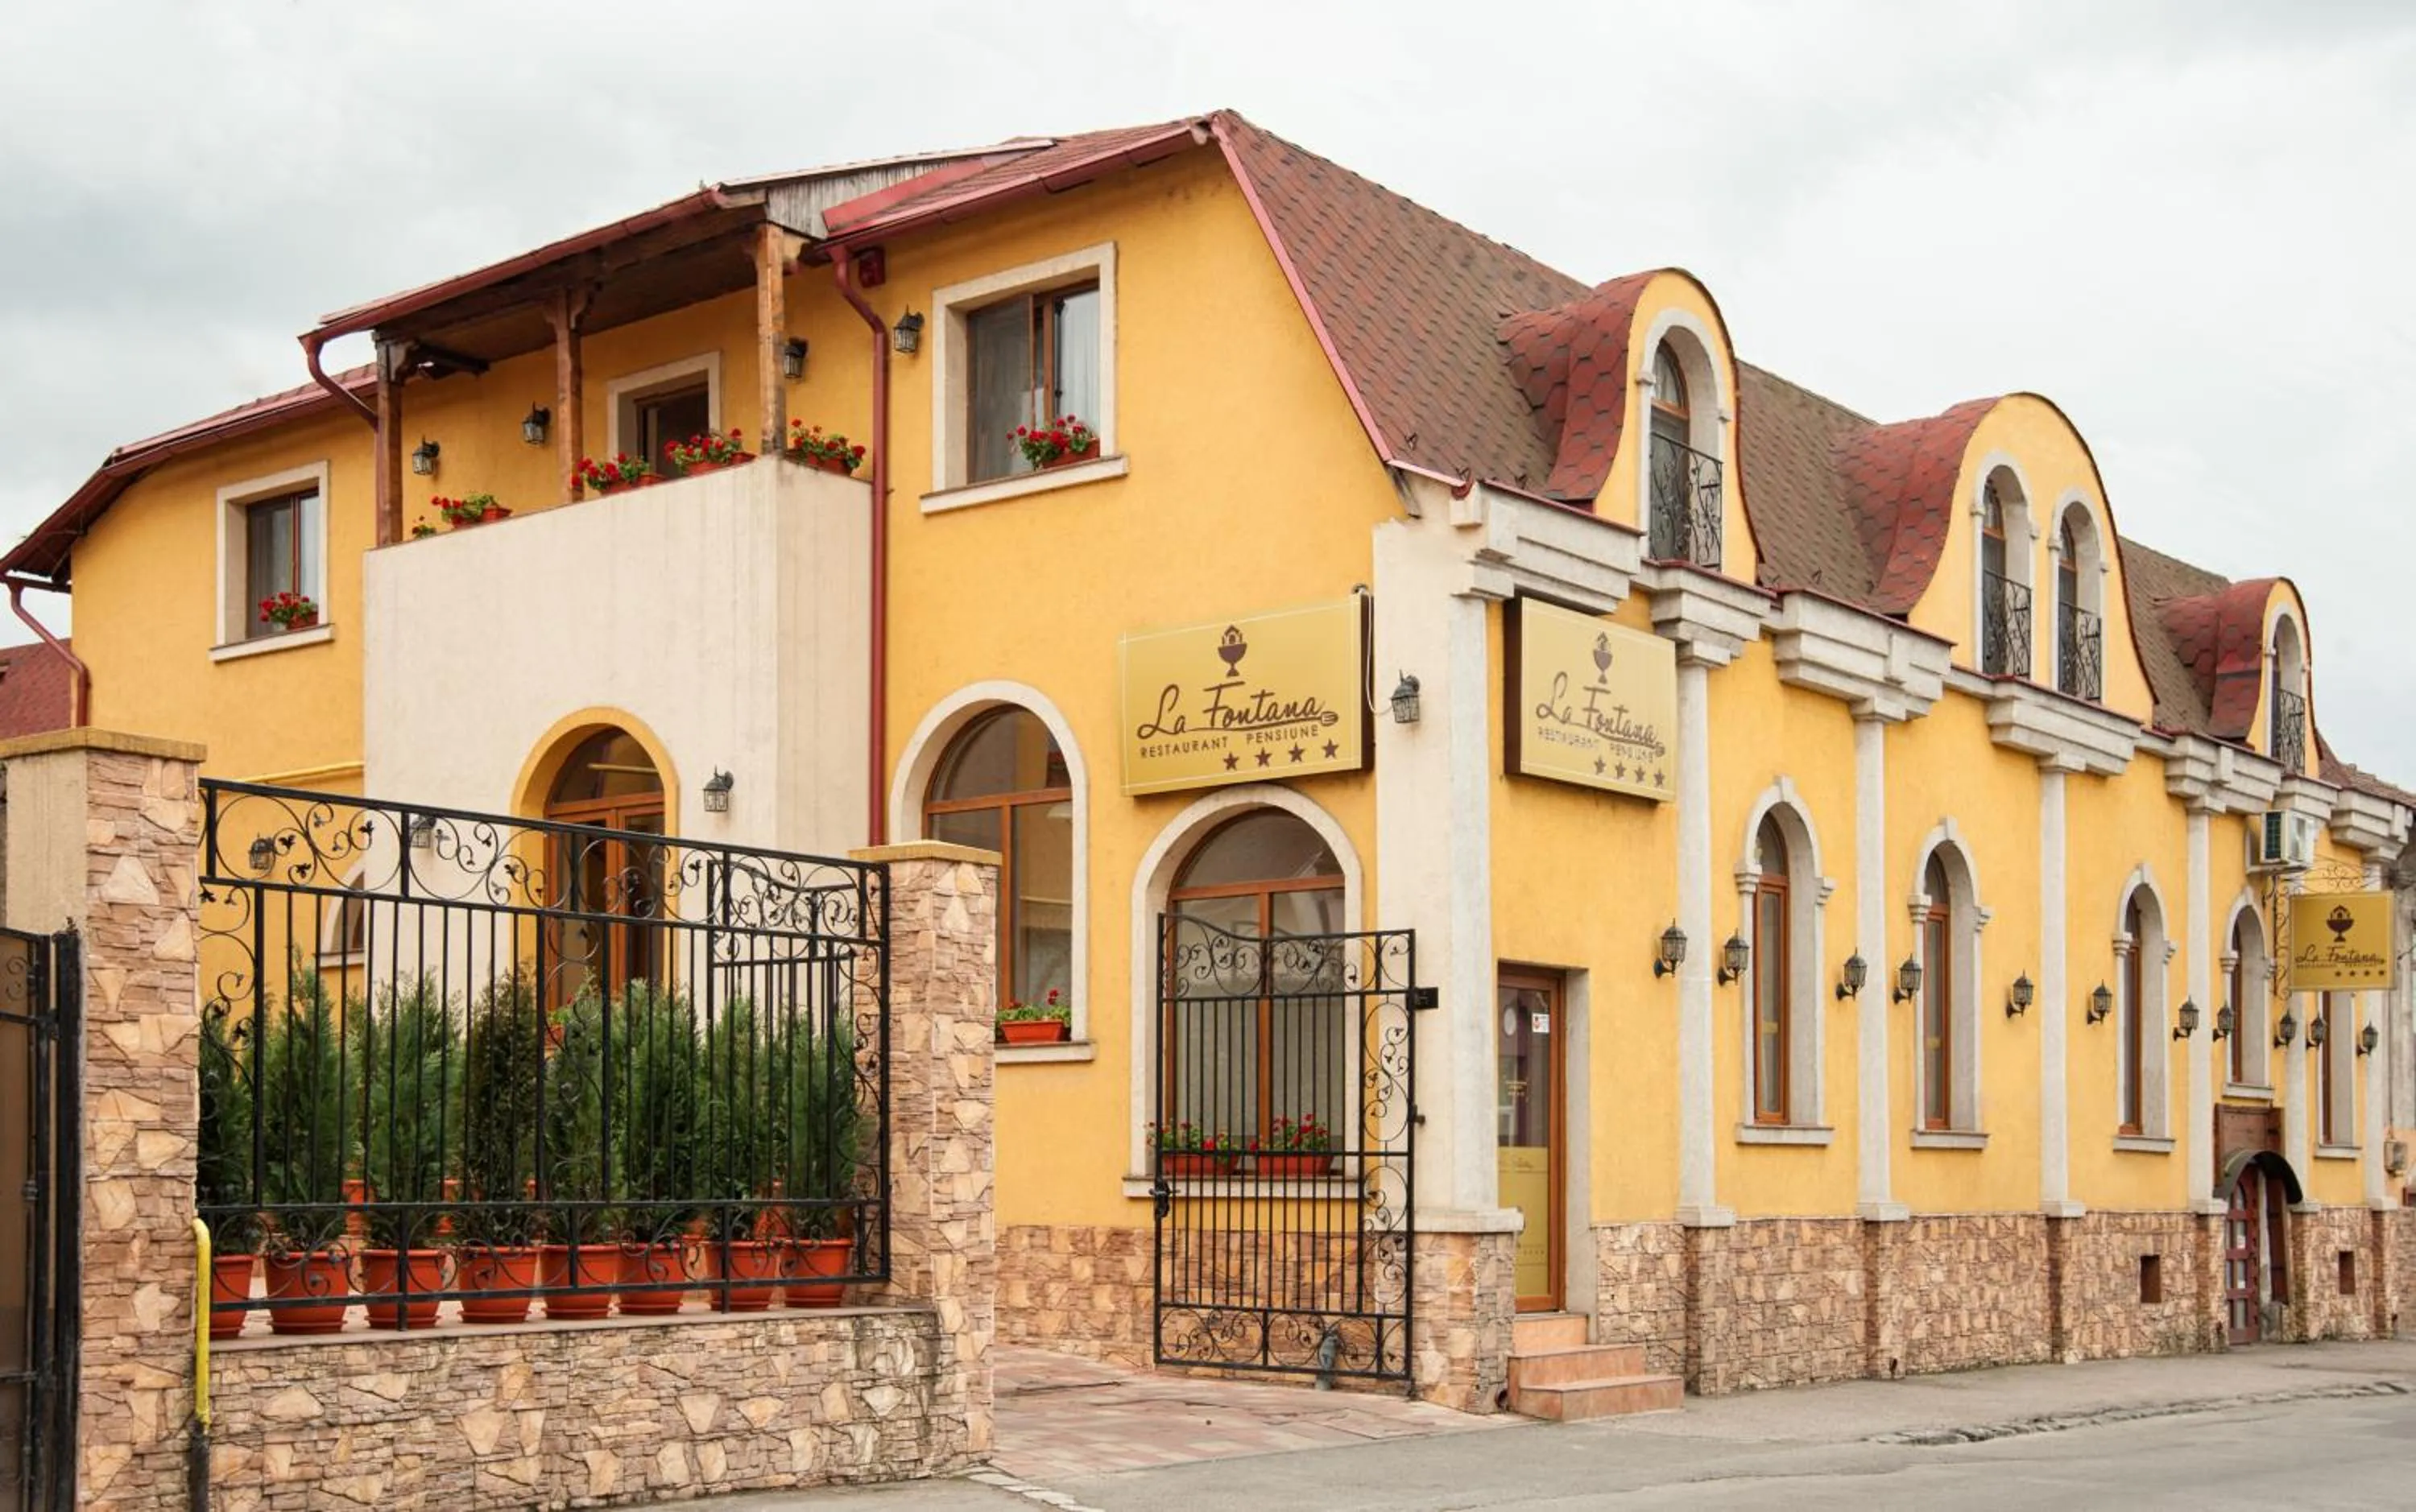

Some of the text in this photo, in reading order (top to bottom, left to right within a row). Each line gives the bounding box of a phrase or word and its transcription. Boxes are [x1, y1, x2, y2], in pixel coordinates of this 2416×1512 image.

[1136, 680, 1325, 739] La Fontana
[1536, 671, 1658, 744] La Fontana
[1140, 724, 1319, 758] RESTAURANT PENSIUNE
[2294, 944, 2377, 963] La Fontana
